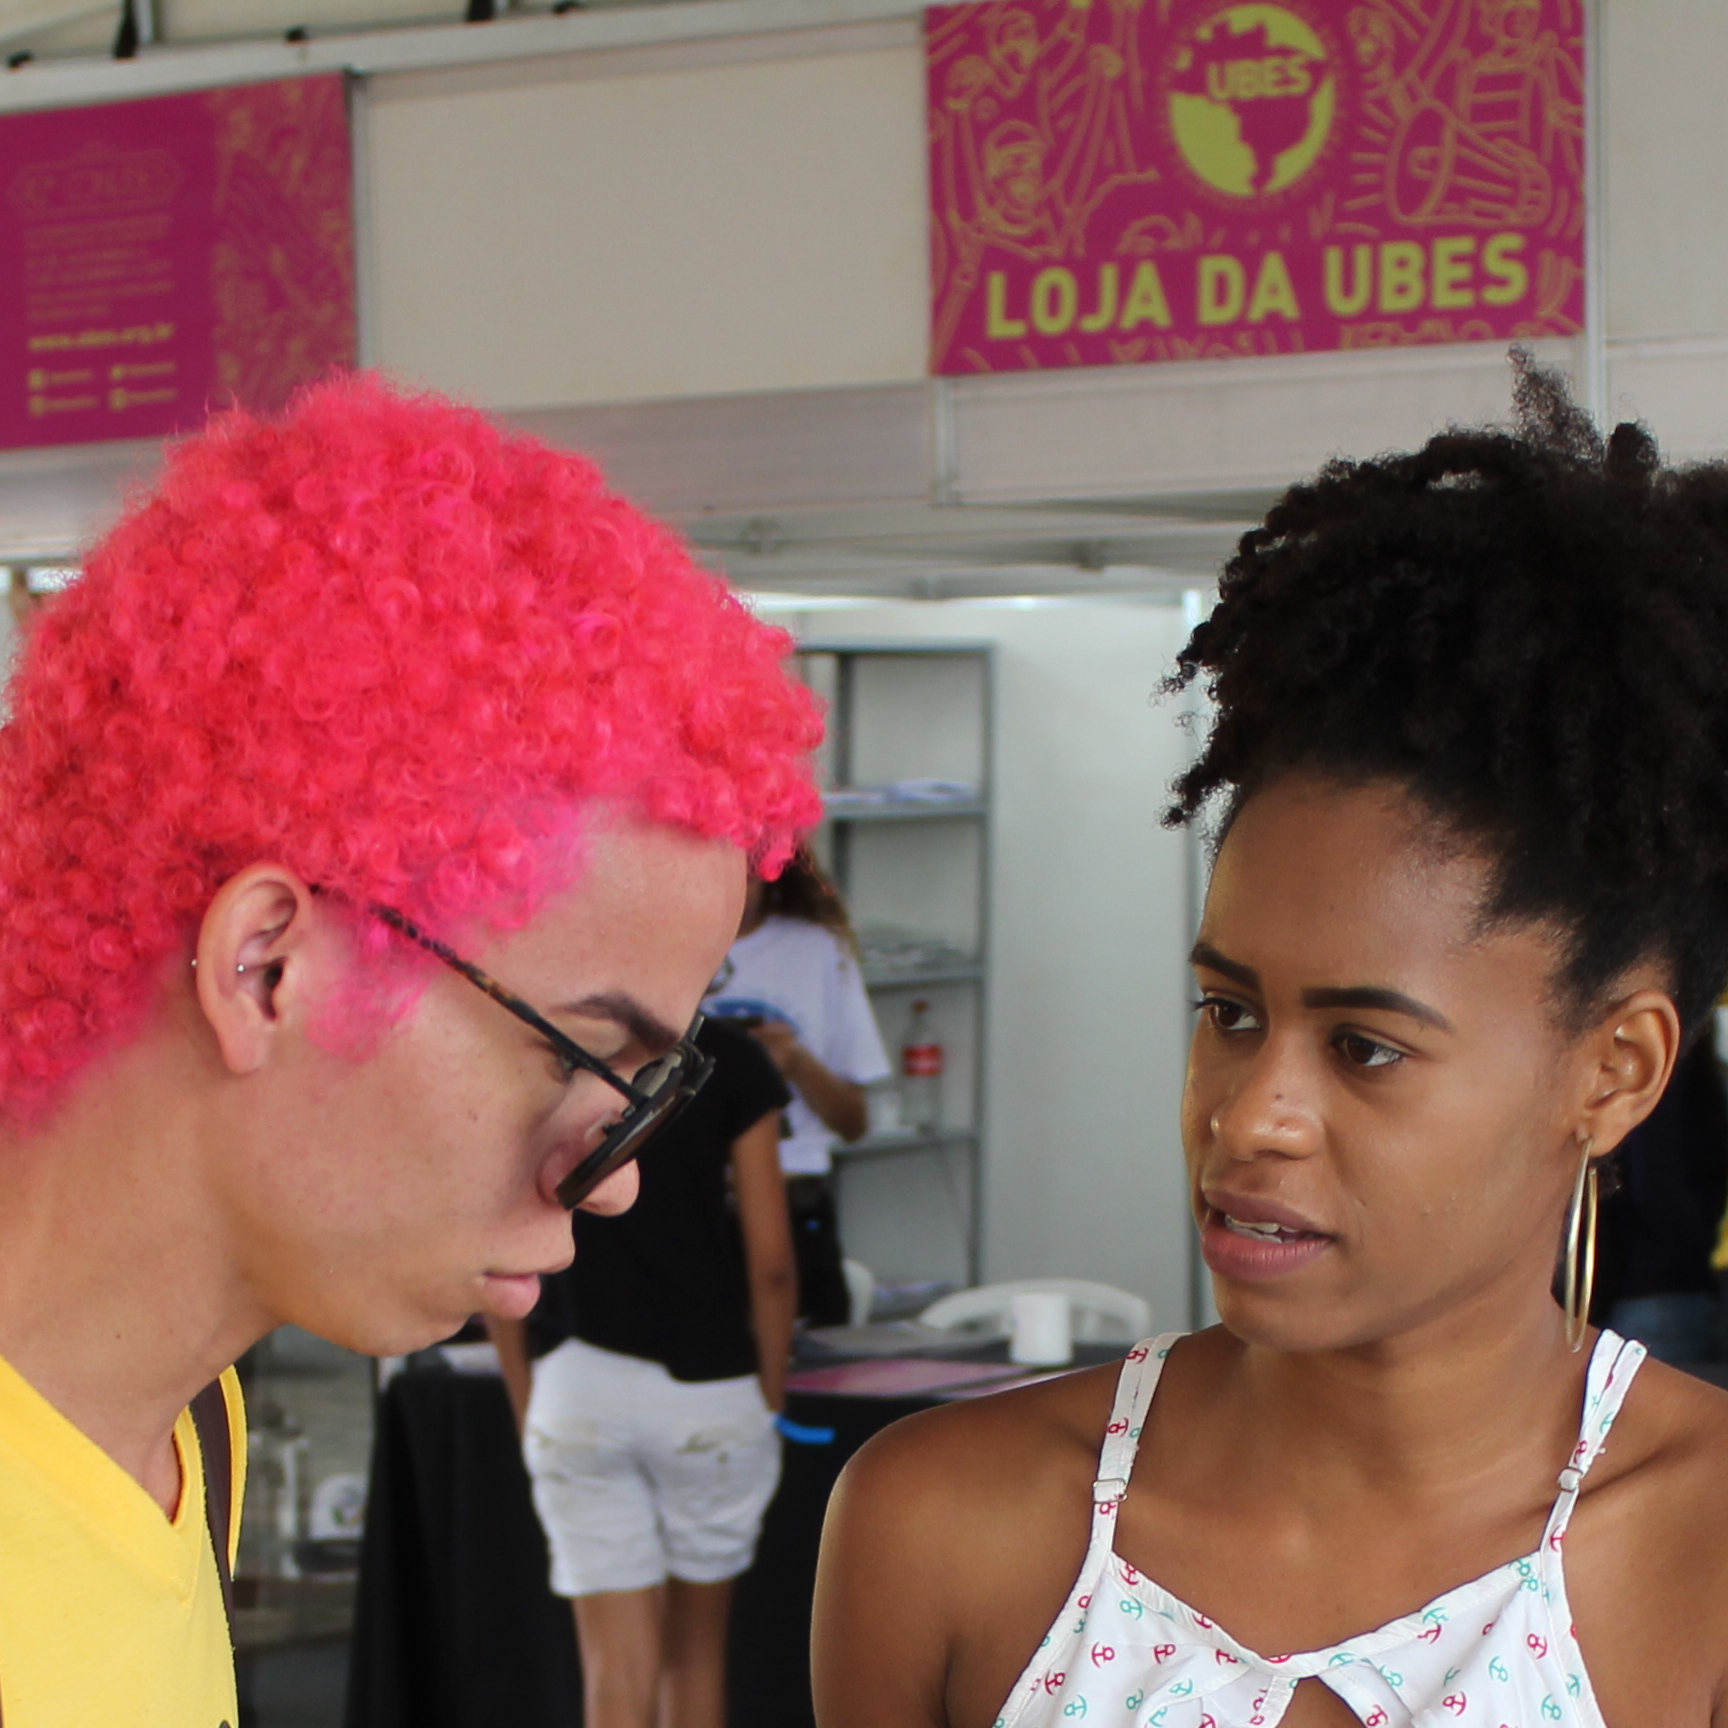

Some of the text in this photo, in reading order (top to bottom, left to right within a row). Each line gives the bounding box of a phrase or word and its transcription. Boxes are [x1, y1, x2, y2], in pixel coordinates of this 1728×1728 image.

[1206, 57, 1312, 101] UBES
[985, 232, 1529, 340] LOJA DA UBES
